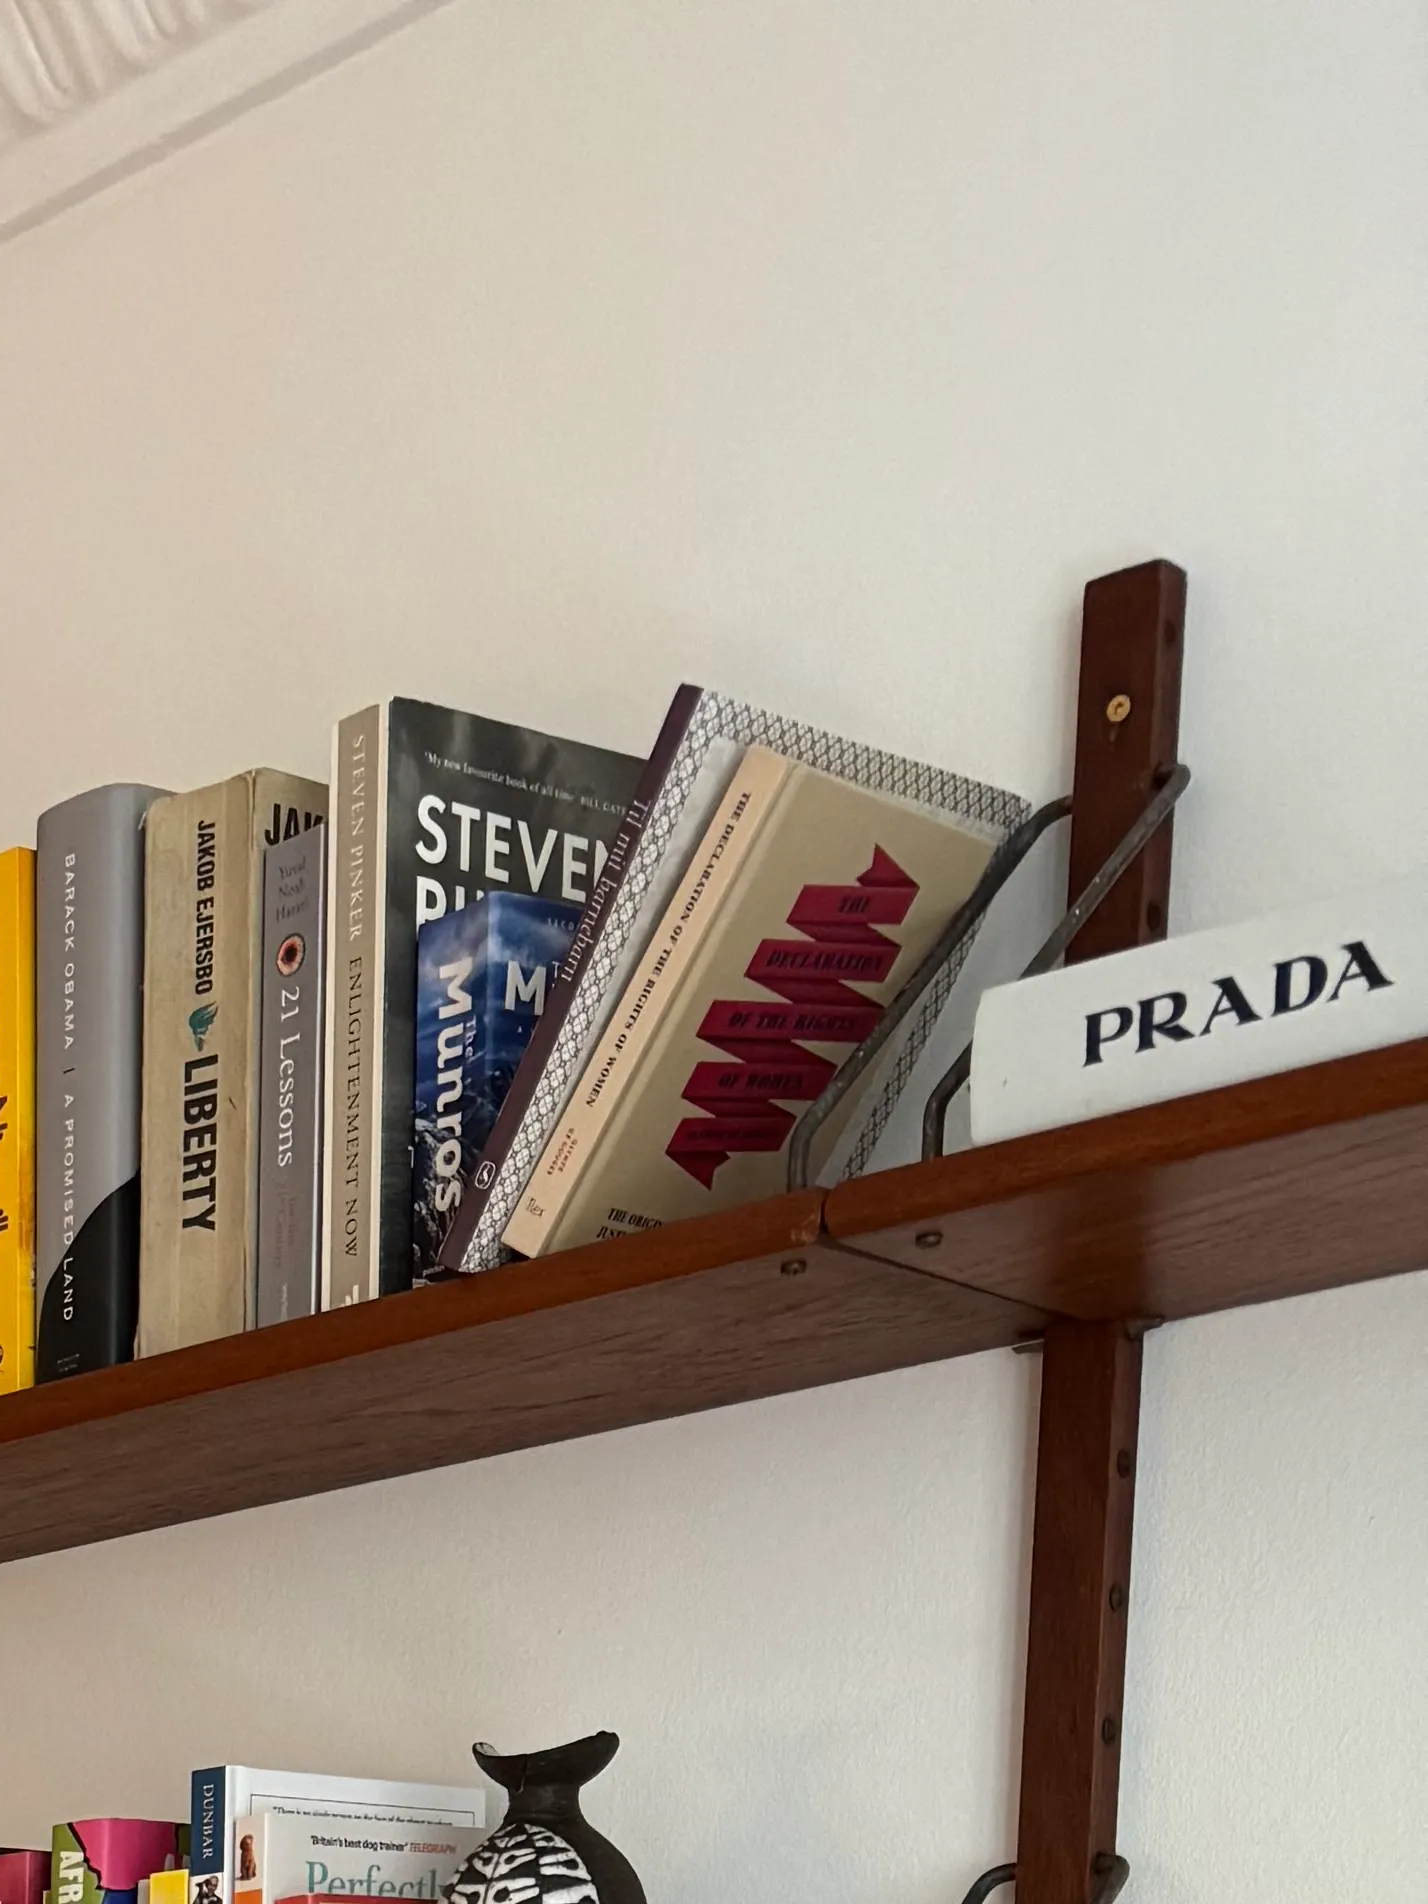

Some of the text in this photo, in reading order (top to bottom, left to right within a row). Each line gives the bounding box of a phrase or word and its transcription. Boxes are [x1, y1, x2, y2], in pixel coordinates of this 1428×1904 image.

[194, 819, 216, 995] JAKOB EJERSBO
[764, 946, 886, 975] DECLARATION
[281, 986, 300, 1019] 21
[1082, 940, 1394, 1068] PRADA
[182, 1053, 219, 1231] LIBERTY
[276, 1030, 297, 1167] Lessons
[343, 957, 362, 1258] ENLIGHTENMENT NOW
[436, 957, 474, 1211] Munros
[201, 1784, 215, 1859] DUNBAR
